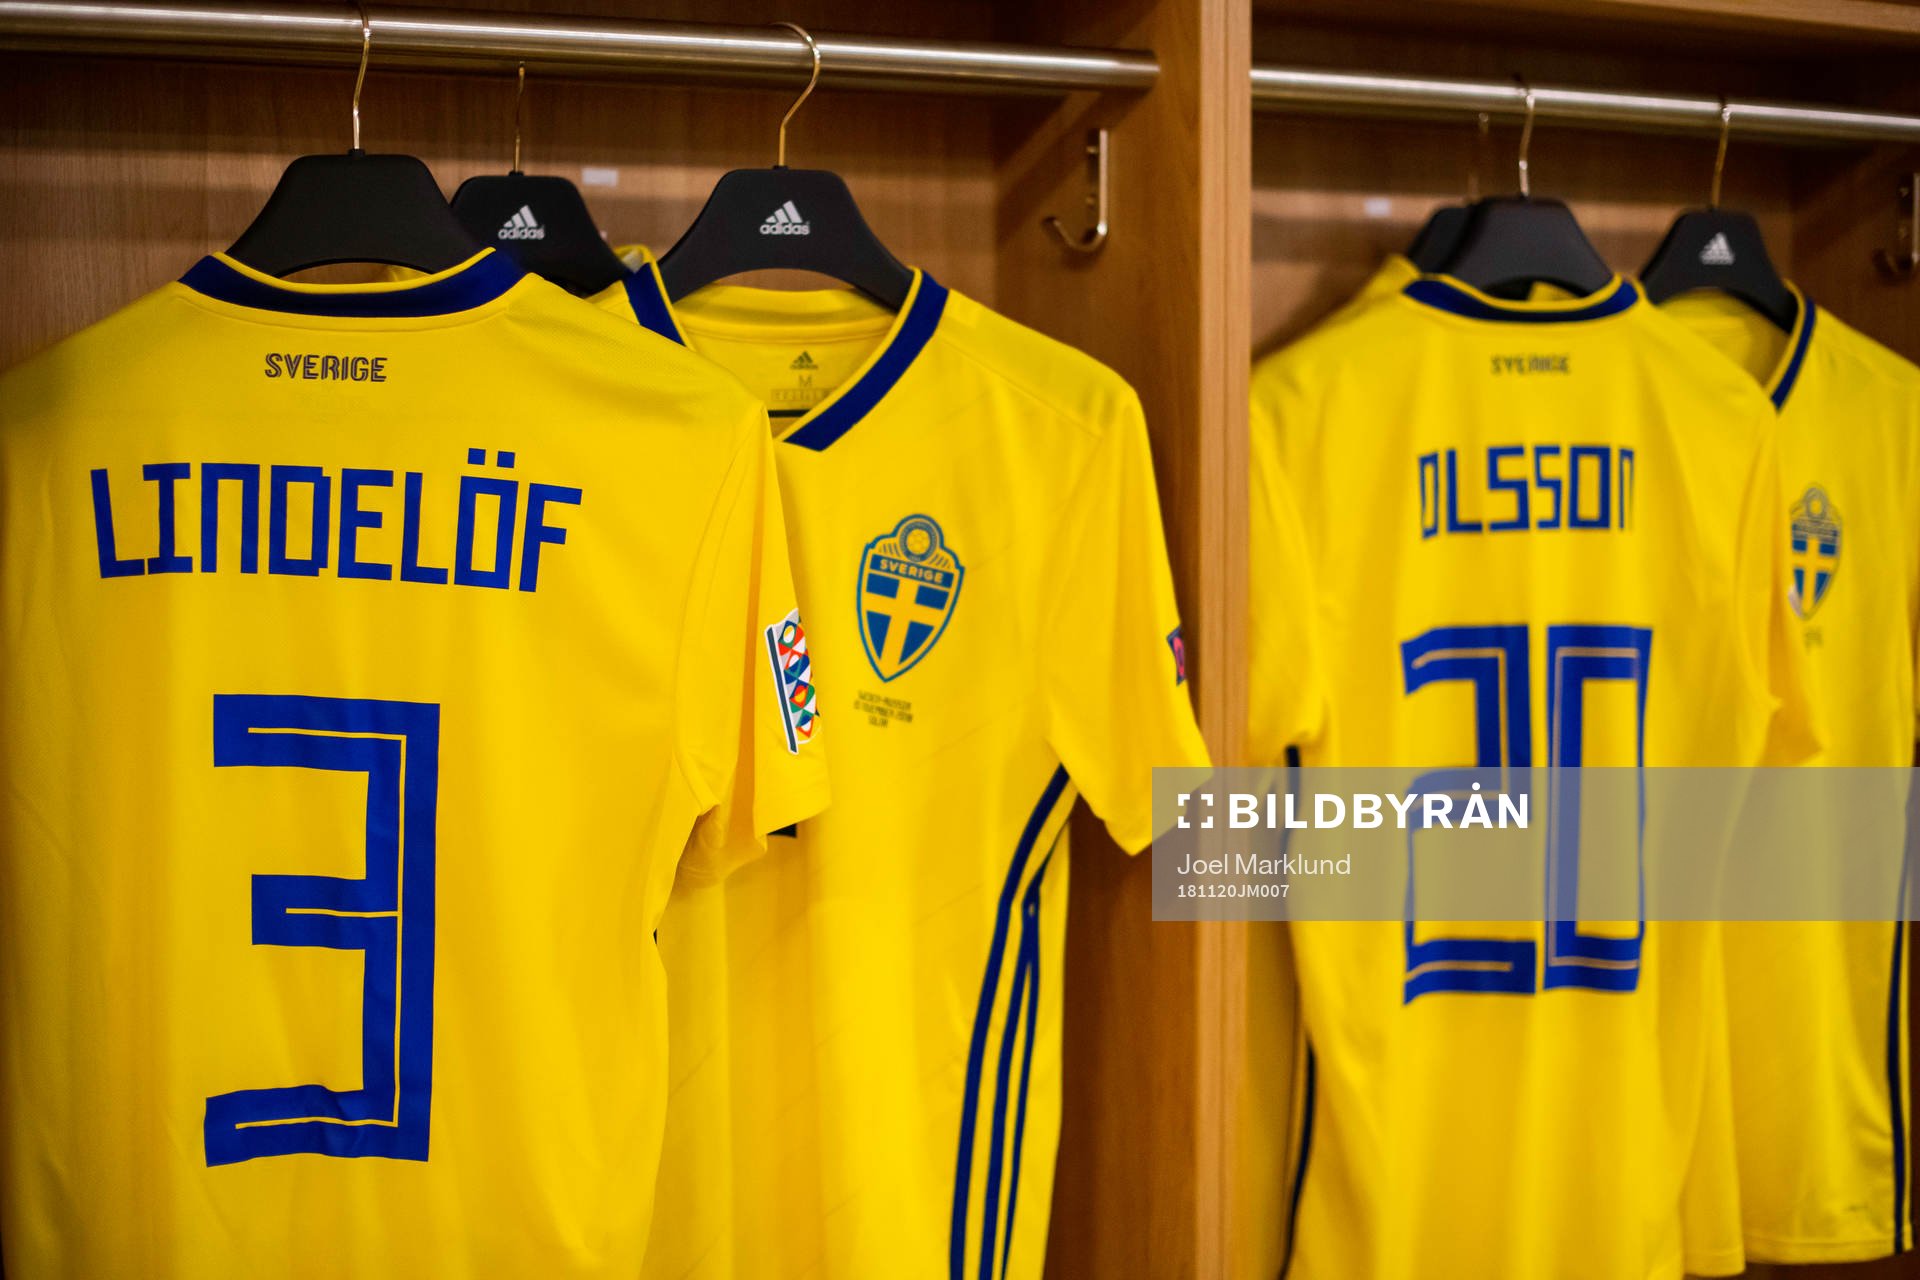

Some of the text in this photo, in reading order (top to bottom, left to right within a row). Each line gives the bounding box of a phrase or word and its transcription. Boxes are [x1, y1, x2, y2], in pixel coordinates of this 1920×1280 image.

[760, 222, 809, 235] adidas
[264, 353, 388, 382] SVERIGE
[90, 447, 584, 593] LINDELÖF
[1417, 444, 1635, 541] OLSSON
[880, 559, 944, 584] SVERIGE
[1400, 624, 1653, 1006] 20
[203, 694, 441, 1167] 3
